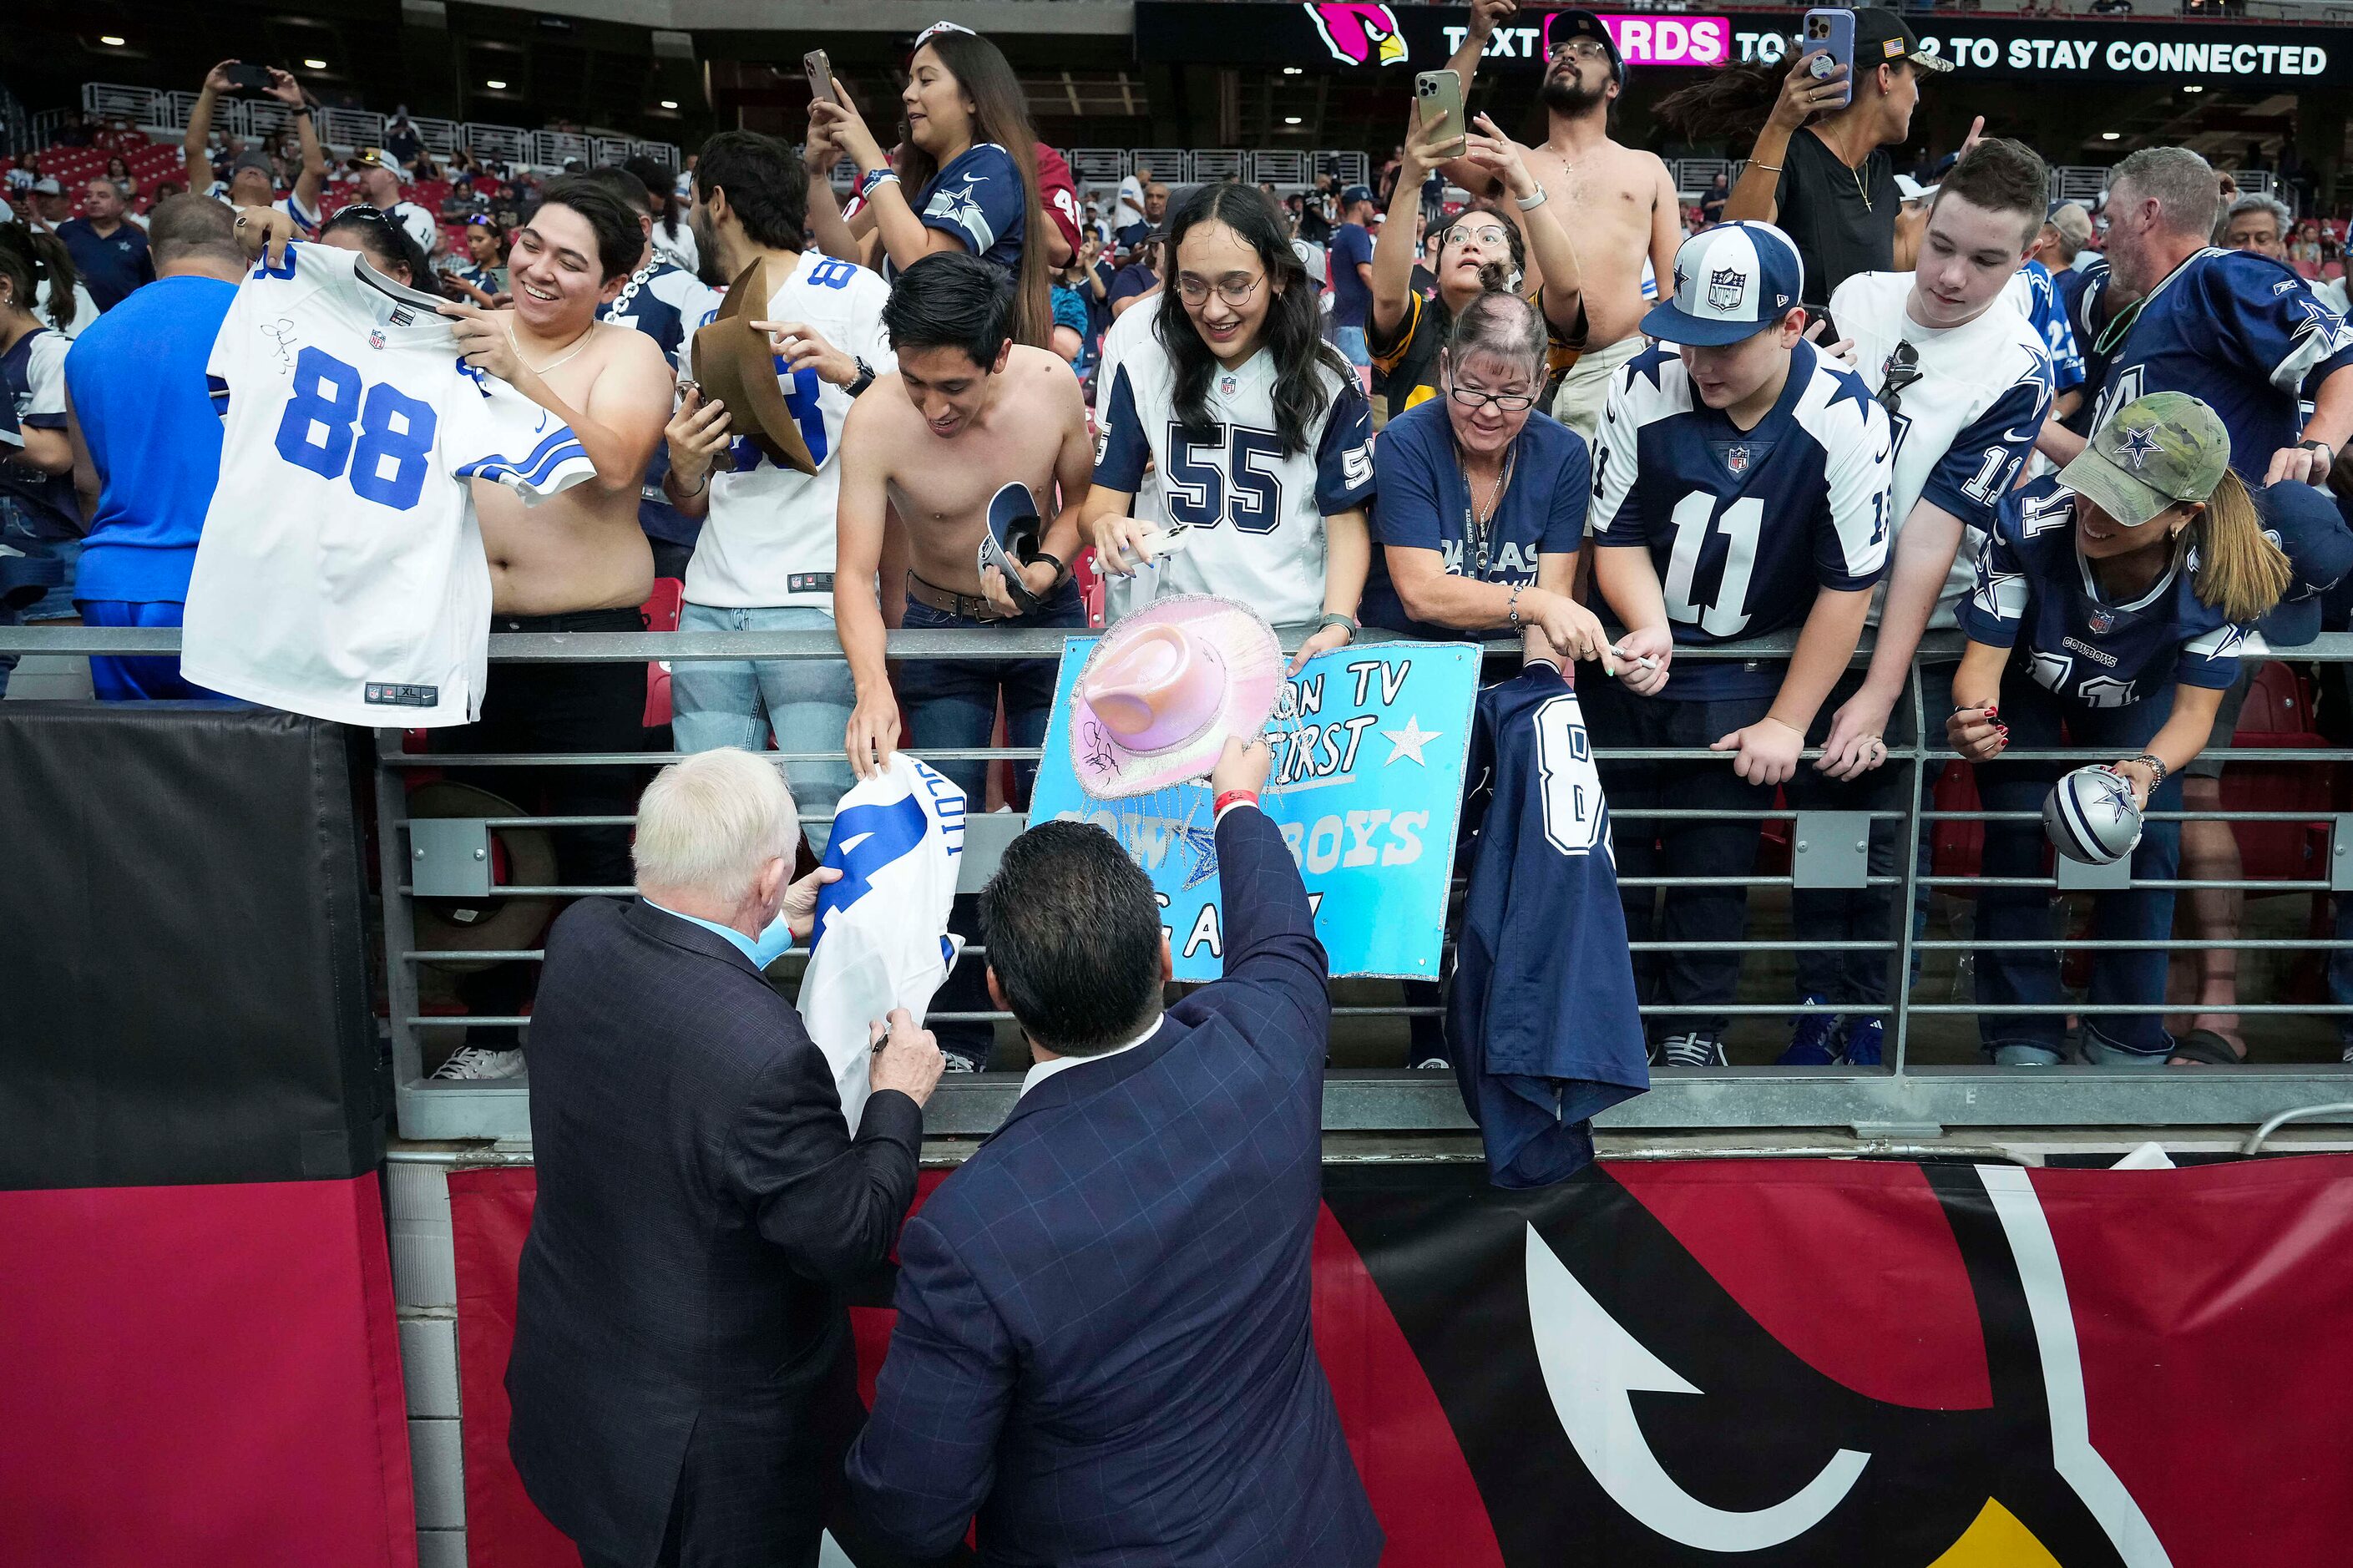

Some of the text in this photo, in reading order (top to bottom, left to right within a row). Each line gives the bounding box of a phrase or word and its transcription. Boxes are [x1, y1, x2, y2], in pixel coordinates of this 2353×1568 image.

[1443, 27, 1540, 57] TXT
[1601, 20, 1722, 61] RDS
[1736, 33, 1785, 63] TO
[1951, 38, 1999, 68] TO
[2007, 38, 2097, 69] STAY
[2106, 41, 2327, 75] CONNECTED
[420, 228, 432, 244] 11
[807, 256, 858, 290] 8
[1710, 285, 1740, 308] NFL
[371, 336, 383, 348] NFL
[1222, 383, 1234, 393] NFL
[274, 345, 438, 511] 88
[1166, 420, 1283, 535] 55
[1731, 458, 1748, 468] NFL
[1870, 483, 1892, 547] 1
[1663, 489, 1765, 637] 11
[2062, 636, 2118, 668] COWBOYS
[402, 687, 417, 696] XL
[1346, 660, 1412, 707] TV
[1532, 692, 1617, 871] 8
[1278, 808, 1430, 875] BOYS
